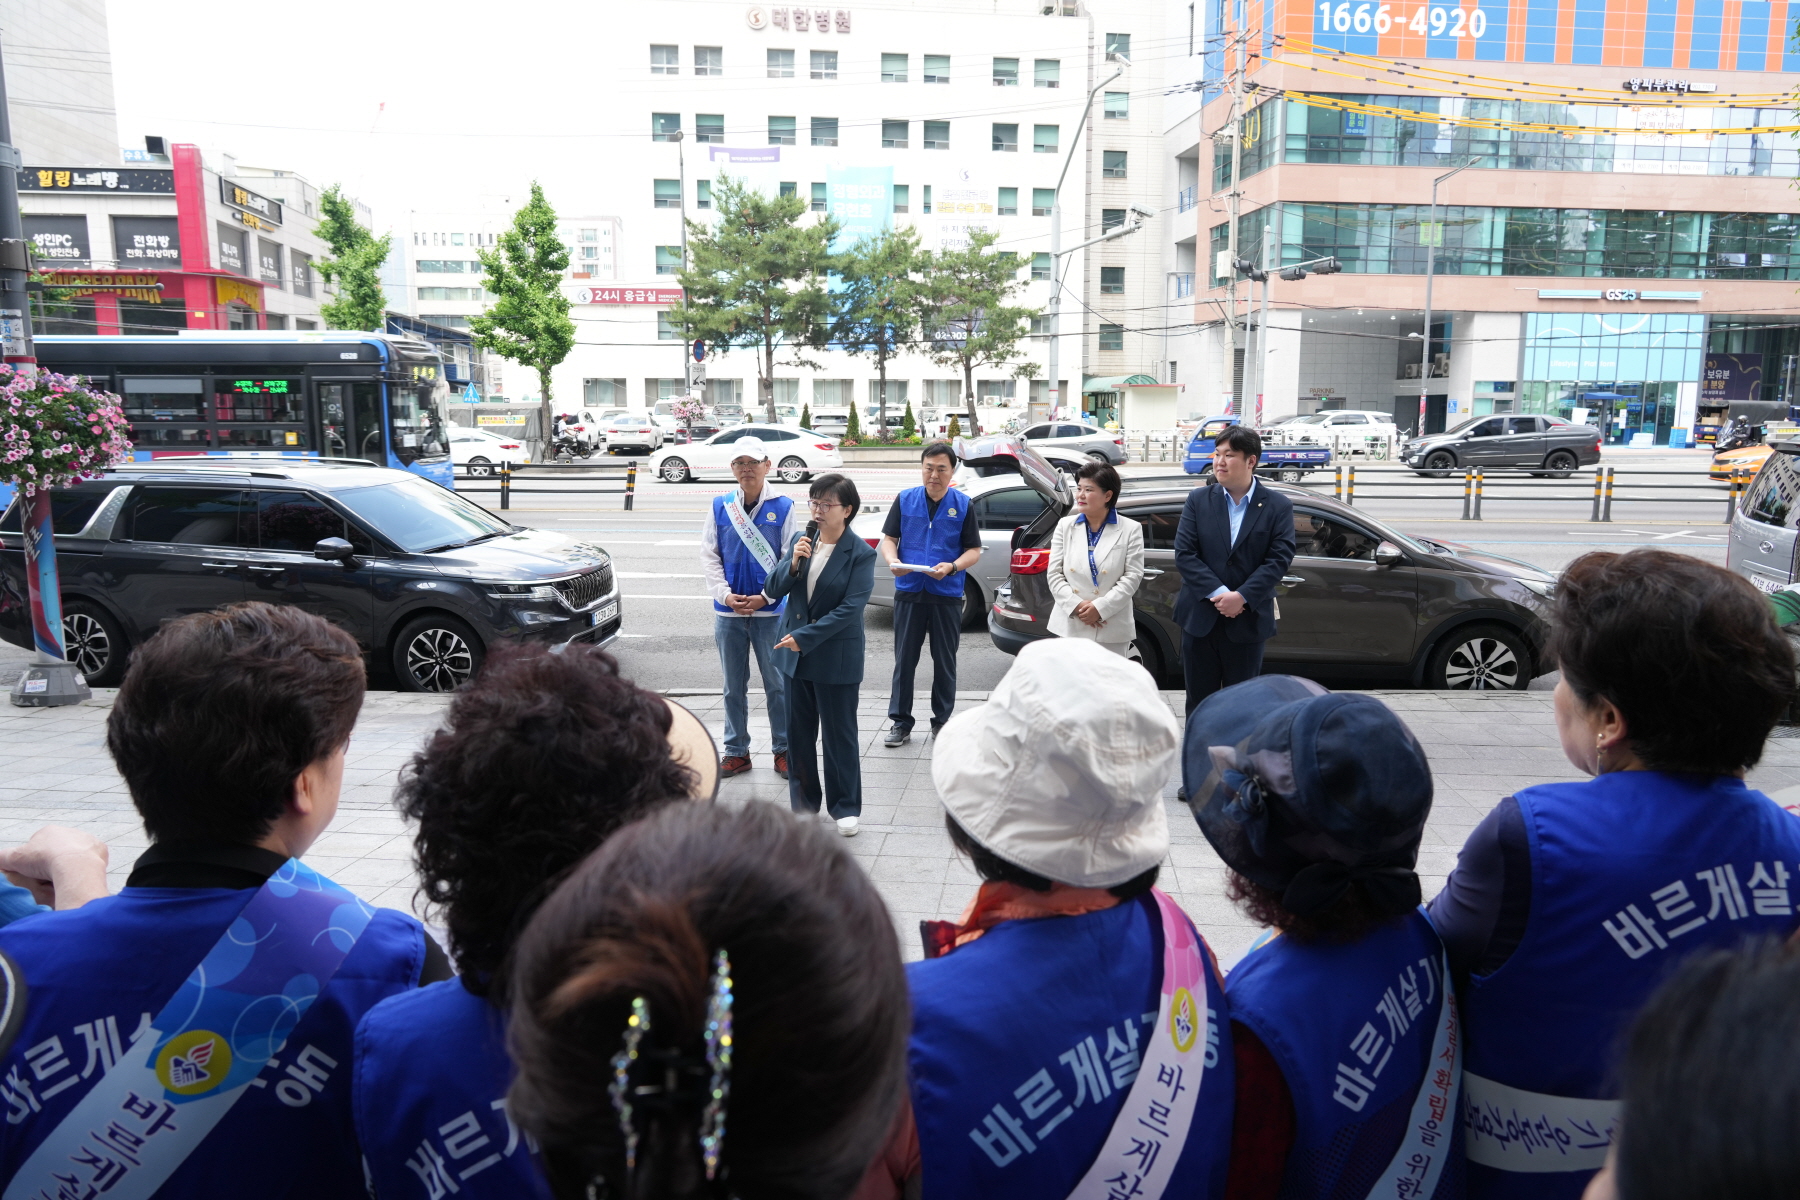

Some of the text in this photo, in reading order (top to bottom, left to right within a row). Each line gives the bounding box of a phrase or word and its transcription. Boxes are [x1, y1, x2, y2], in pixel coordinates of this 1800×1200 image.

[772, 7, 851, 33] 대한병원
[1319, 2, 1487, 38] 1666-4920
[1629, 77, 1688, 92] 영피부관리
[957, 203, 975, 213] 수술
[33, 234, 72, 246] 성인PC
[133, 235, 170, 248] 전화방
[115, 274, 161, 303] PARK
[1606, 289, 1636, 301] GS25
[595, 290, 656, 302] 24시 응급실
[1602, 861, 1800, 960] 바르게살
